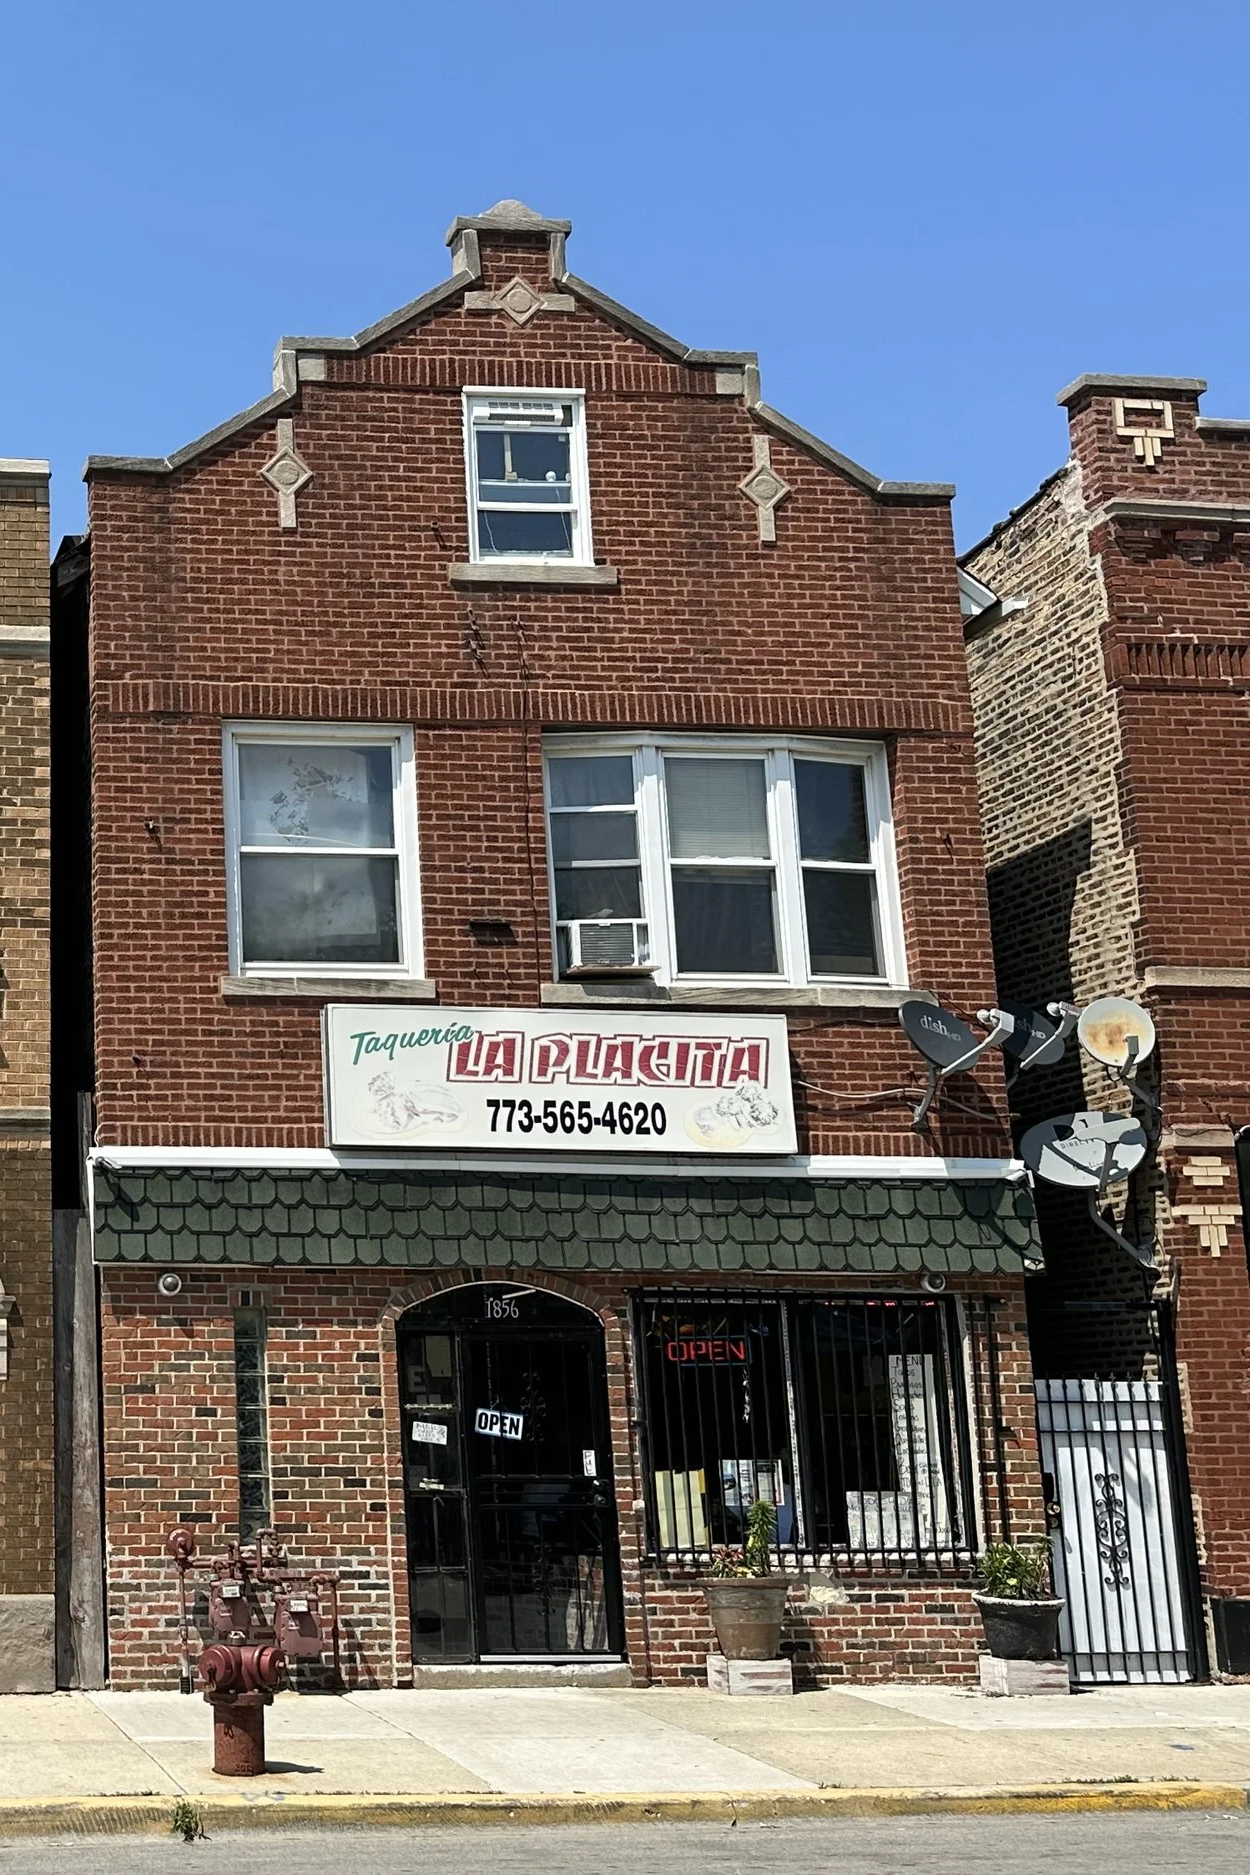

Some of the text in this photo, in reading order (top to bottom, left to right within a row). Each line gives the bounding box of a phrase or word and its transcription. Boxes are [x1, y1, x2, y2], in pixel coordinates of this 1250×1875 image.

[920, 1014, 948, 1035] dish
[350, 1022, 473, 1065] Taquería
[446, 1030, 770, 1090] LA PLACITA
[486, 1098, 667, 1136] 773-565-4620
[485, 1297, 519, 1319] 1856
[667, 1341, 745, 1360] OPEN
[477, 1411, 520, 1436] OPEN
